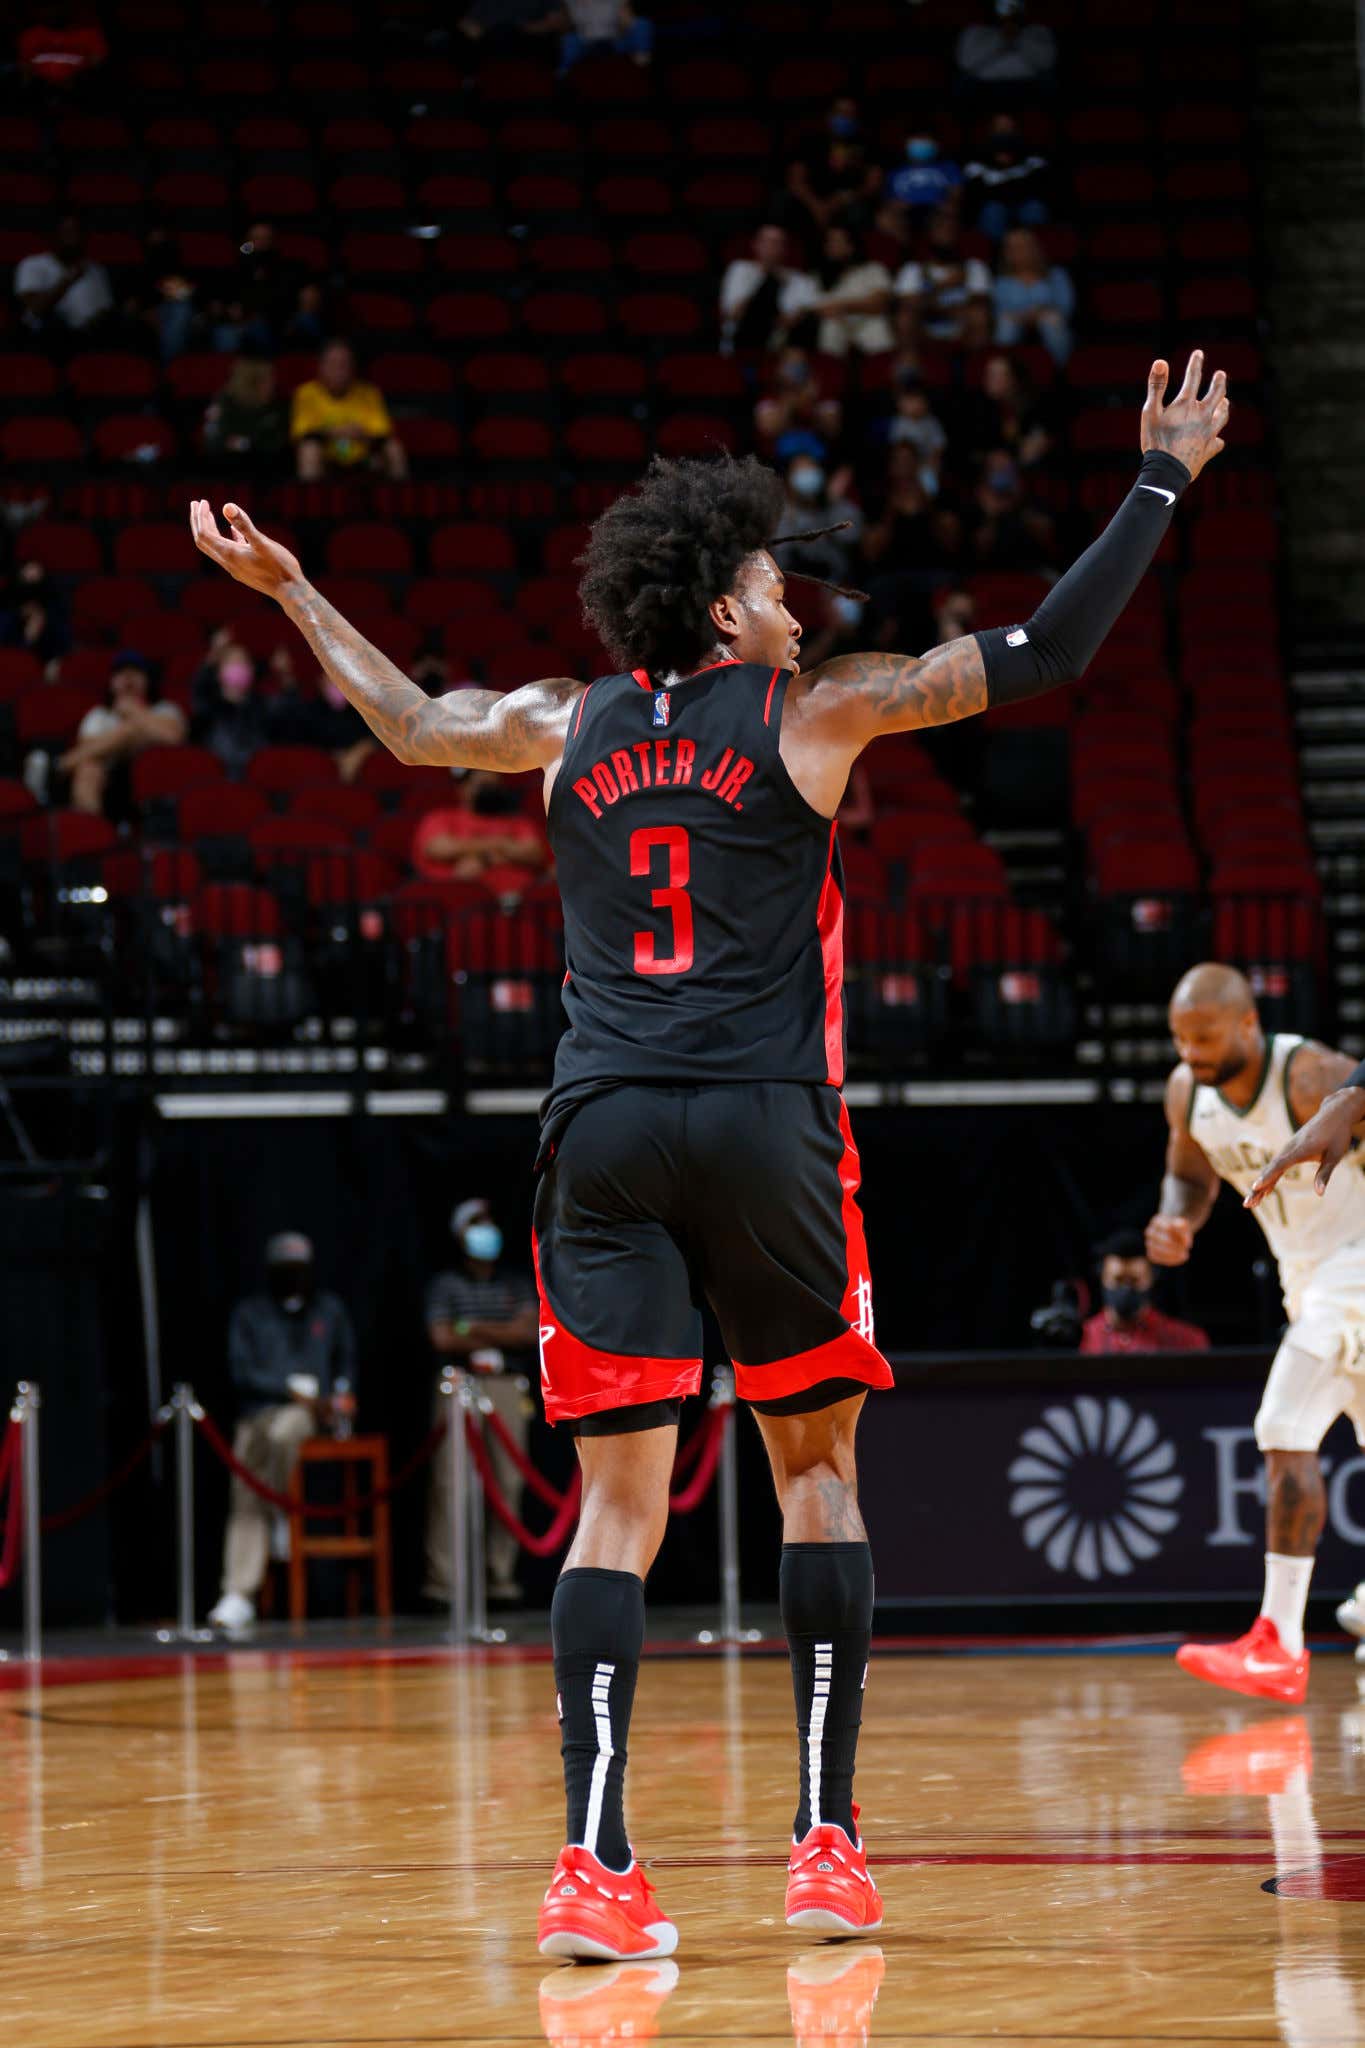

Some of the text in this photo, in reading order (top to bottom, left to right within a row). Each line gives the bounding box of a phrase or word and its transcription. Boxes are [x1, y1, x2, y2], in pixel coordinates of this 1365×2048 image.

[572, 739, 754, 818] PORTER JR.
[630, 826, 694, 974] 3
